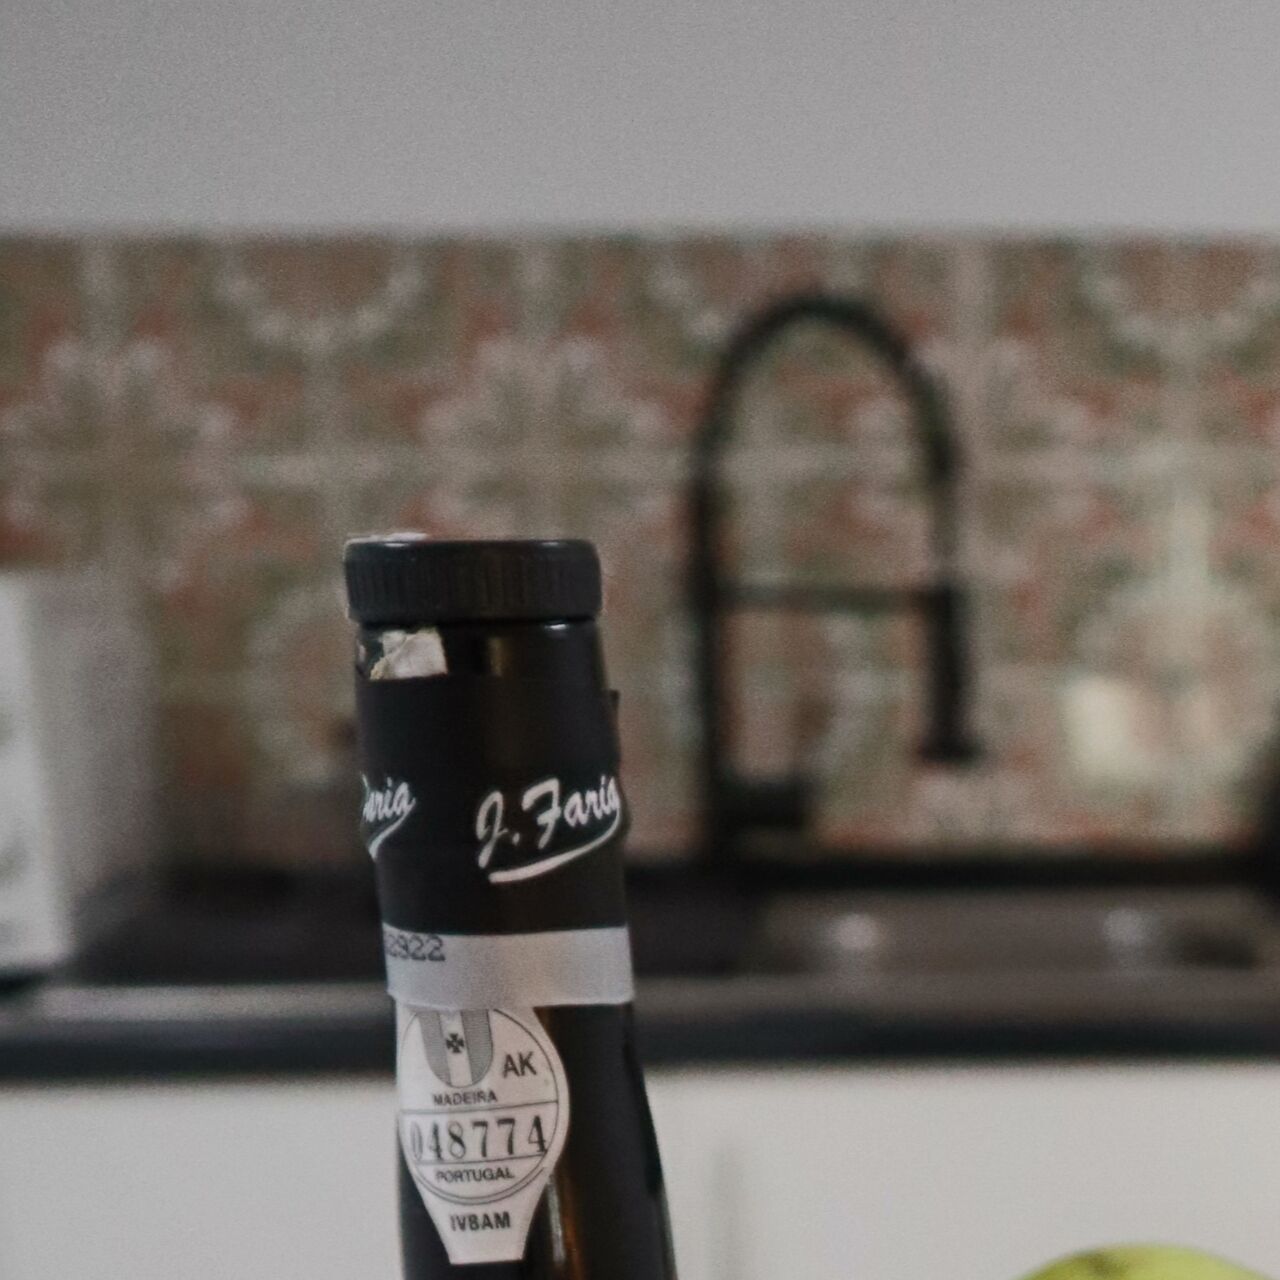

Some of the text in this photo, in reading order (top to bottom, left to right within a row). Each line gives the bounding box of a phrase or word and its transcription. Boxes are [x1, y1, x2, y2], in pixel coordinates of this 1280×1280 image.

[522, 774, 621, 849] Faria
[502, 1050, 538, 1079] AK
[433, 1091, 499, 1107] MADEIRA
[410, 1115, 547, 1162] 048774
[436, 1167, 515, 1184] PORTUGAL
[450, 1211, 511, 1231] IVBAM
